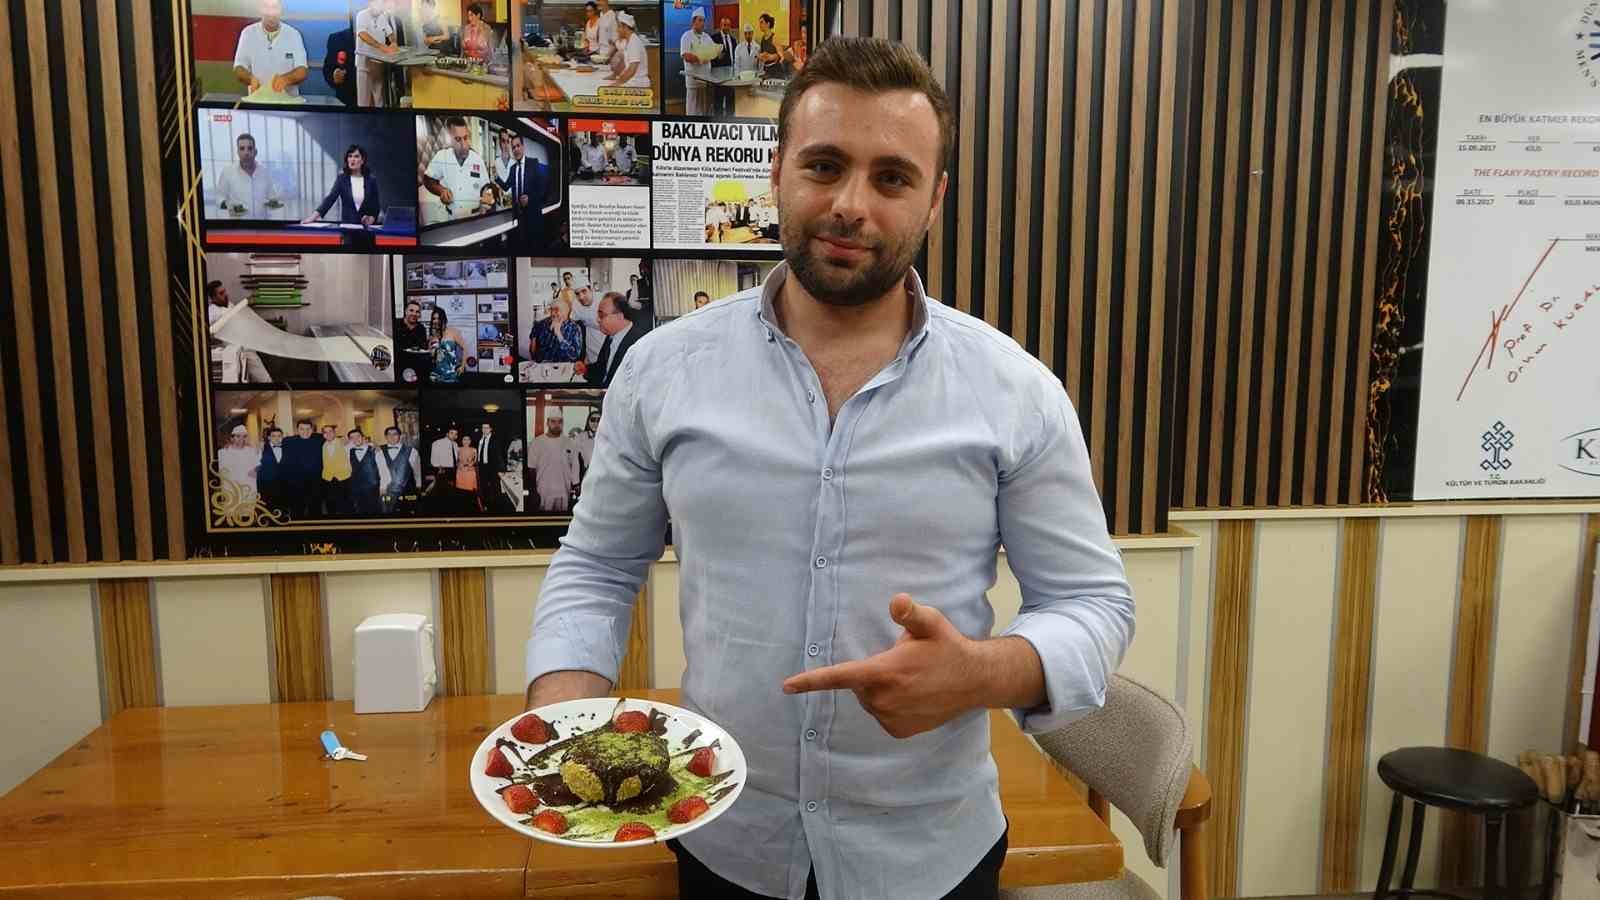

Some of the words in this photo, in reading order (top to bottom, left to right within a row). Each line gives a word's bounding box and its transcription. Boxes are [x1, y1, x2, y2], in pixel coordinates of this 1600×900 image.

[1479, 114, 1492, 123] EN
[1494, 112, 1527, 123] BÜYÜK
[1529, 115, 1568, 124] KATMER
[662, 123, 742, 142] BAKLAVACI
[652, 143, 702, 162] DÜNYA
[706, 147, 764, 163] REKORU
[1473, 168, 1491, 176] THE
[1493, 168, 1522, 176] FLAKY
[1522, 169, 1560, 177] PASTRY
[1562, 170, 1599, 178] RECORD
